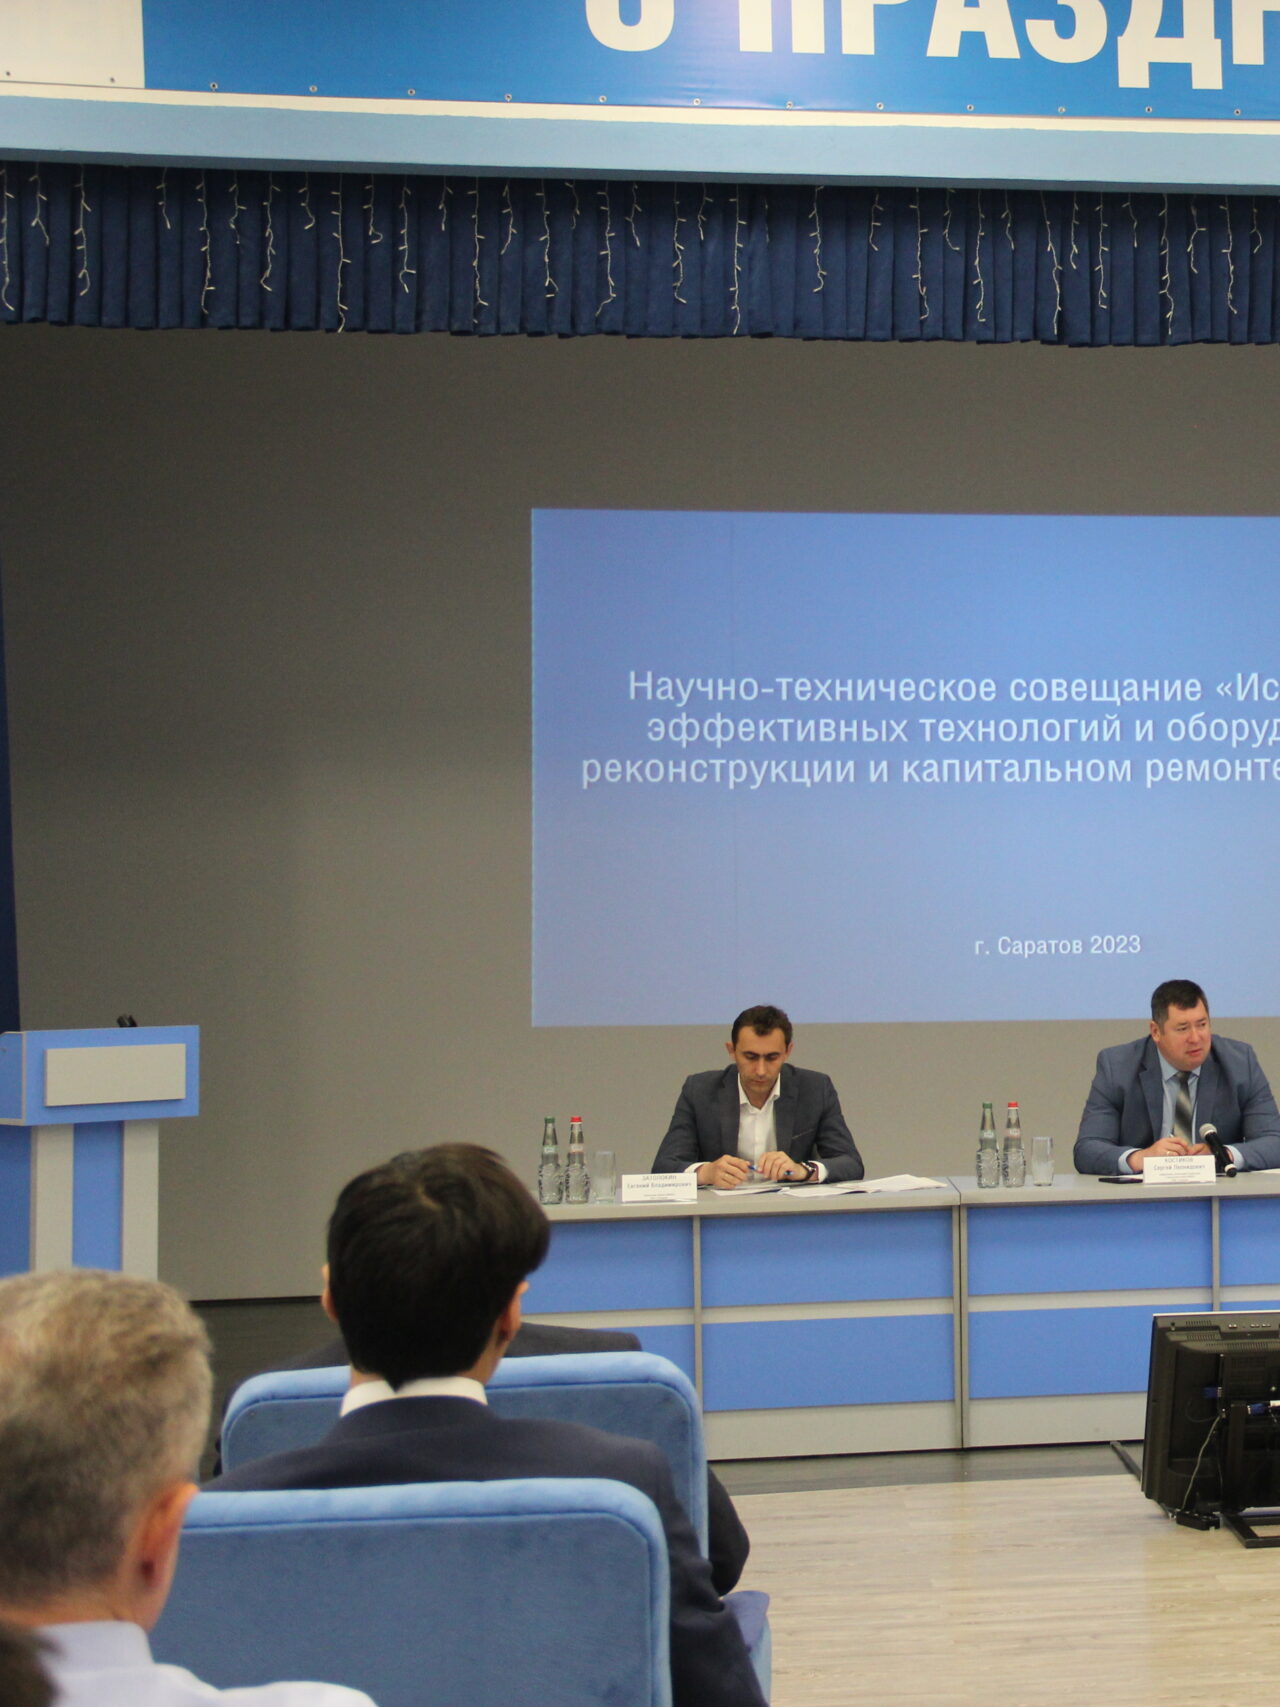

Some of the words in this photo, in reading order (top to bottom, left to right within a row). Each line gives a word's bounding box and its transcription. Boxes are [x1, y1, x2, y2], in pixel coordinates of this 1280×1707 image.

[629, 671, 997, 707] Научно-техническое
[1010, 677, 1202, 706] совещание
[647, 712, 908, 748] эффективных
[919, 713, 1122, 743] технологий
[1135, 717, 1154, 742] и
[582, 758, 855, 790] реконструкции
[869, 759, 889, 783] и
[903, 757, 1132, 783] капитальном
[974, 940, 990, 955] г.
[998, 935, 1083, 959] Саратов
[1090, 934, 1142, 954] 2023
